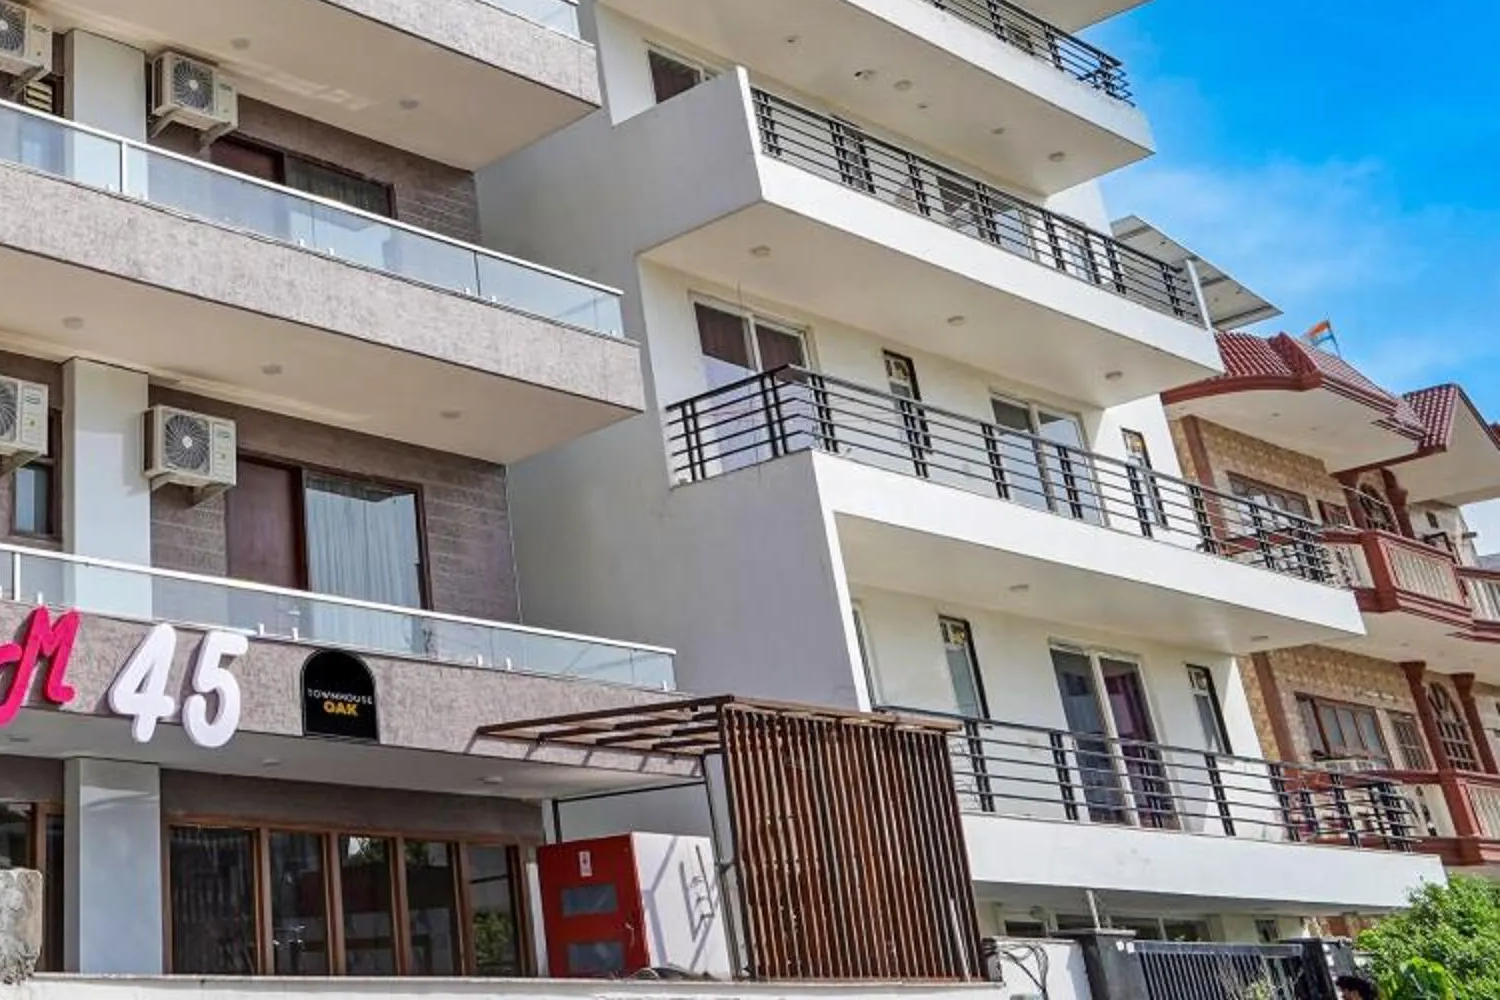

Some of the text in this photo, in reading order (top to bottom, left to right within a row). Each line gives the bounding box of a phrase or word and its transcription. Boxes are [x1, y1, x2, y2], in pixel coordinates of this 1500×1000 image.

[108, 622, 249, 748] 45
[307, 688, 373, 705] TOWNHOUSE
[323, 700, 359, 717] OAK
